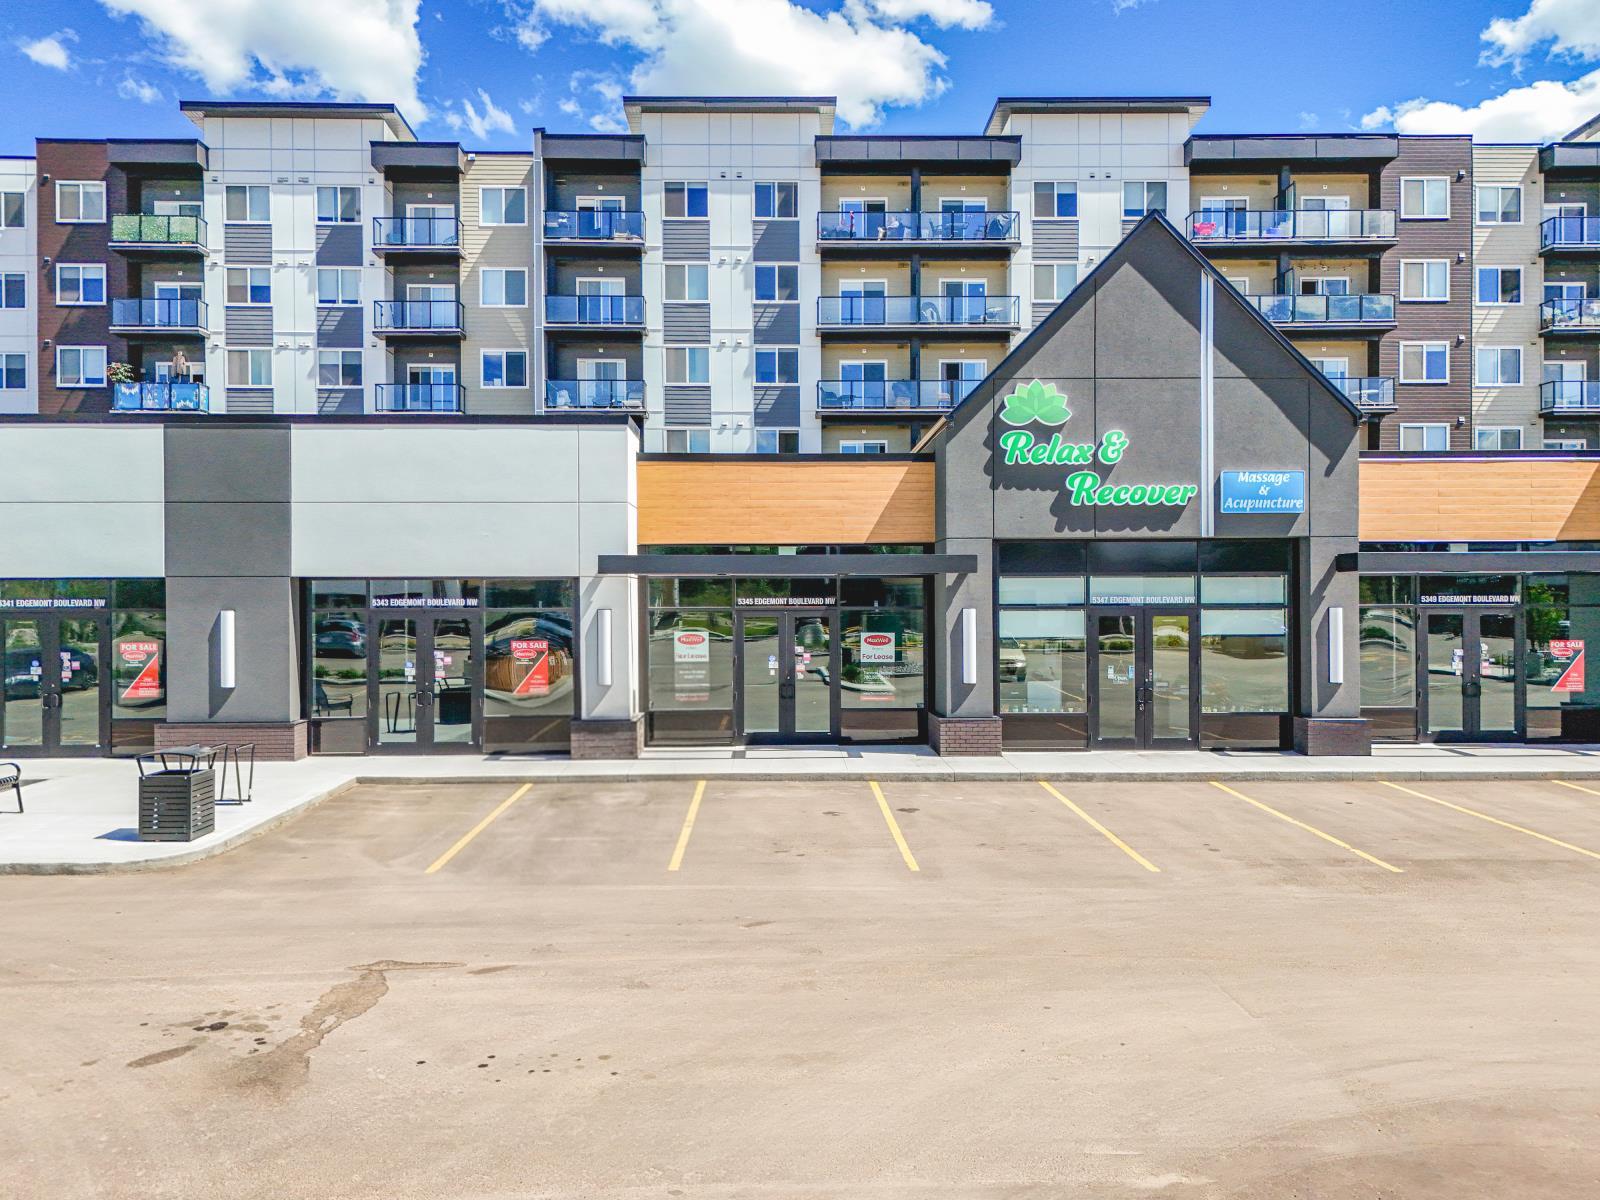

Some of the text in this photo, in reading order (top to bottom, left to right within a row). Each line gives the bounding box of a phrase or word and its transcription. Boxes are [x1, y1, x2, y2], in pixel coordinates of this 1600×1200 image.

[1000, 430, 1129, 465] Relax &
[1238, 472, 1290, 486] Massage
[1065, 471, 1198, 507] Recover
[1259, 485, 1270, 496] &
[1225, 498, 1303, 512] Acupuncture
[16, 599, 52, 607] EDGEMONT
[54, 599, 93, 607] BOULEVARD
[94, 599, 106, 607] NW
[372, 598, 478, 607] 5343 EDGEMONT BOULEVARD NW
[737, 597, 836, 605] 5345 EDGEMONT BOULEVARD NW
[1092, 596, 1196, 604] 5347 EDGEMONT BOULEVARD NW
[1420, 595, 1521, 604] 5349 EDGEMONT BOULEVARD NW
[121, 643, 158, 651] FOR SALE
